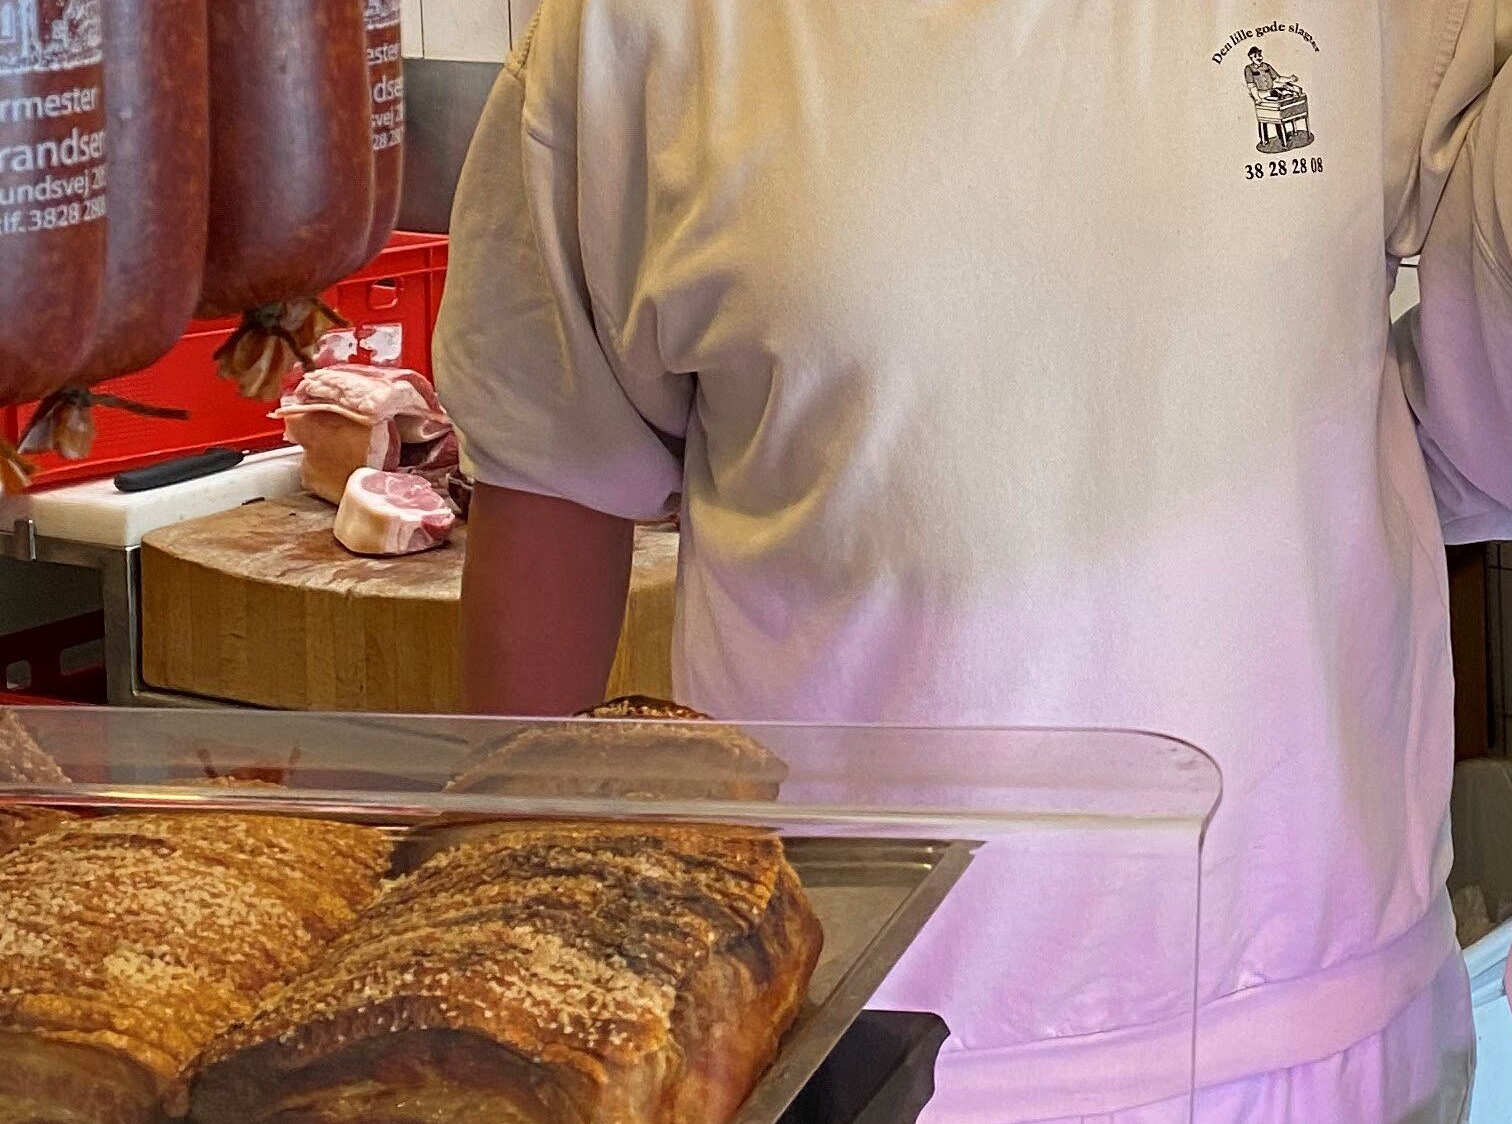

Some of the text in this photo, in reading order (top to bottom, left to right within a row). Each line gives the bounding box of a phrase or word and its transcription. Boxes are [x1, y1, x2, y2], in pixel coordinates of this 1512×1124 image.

[1211, 39, 1233, 66] Den
[1229, 28, 1254, 47] lille
[1255, 20, 1286, 38] gode
[1244, 156, 1324, 180] 38 28 28 08
[28, 200, 81, 232] 3828
